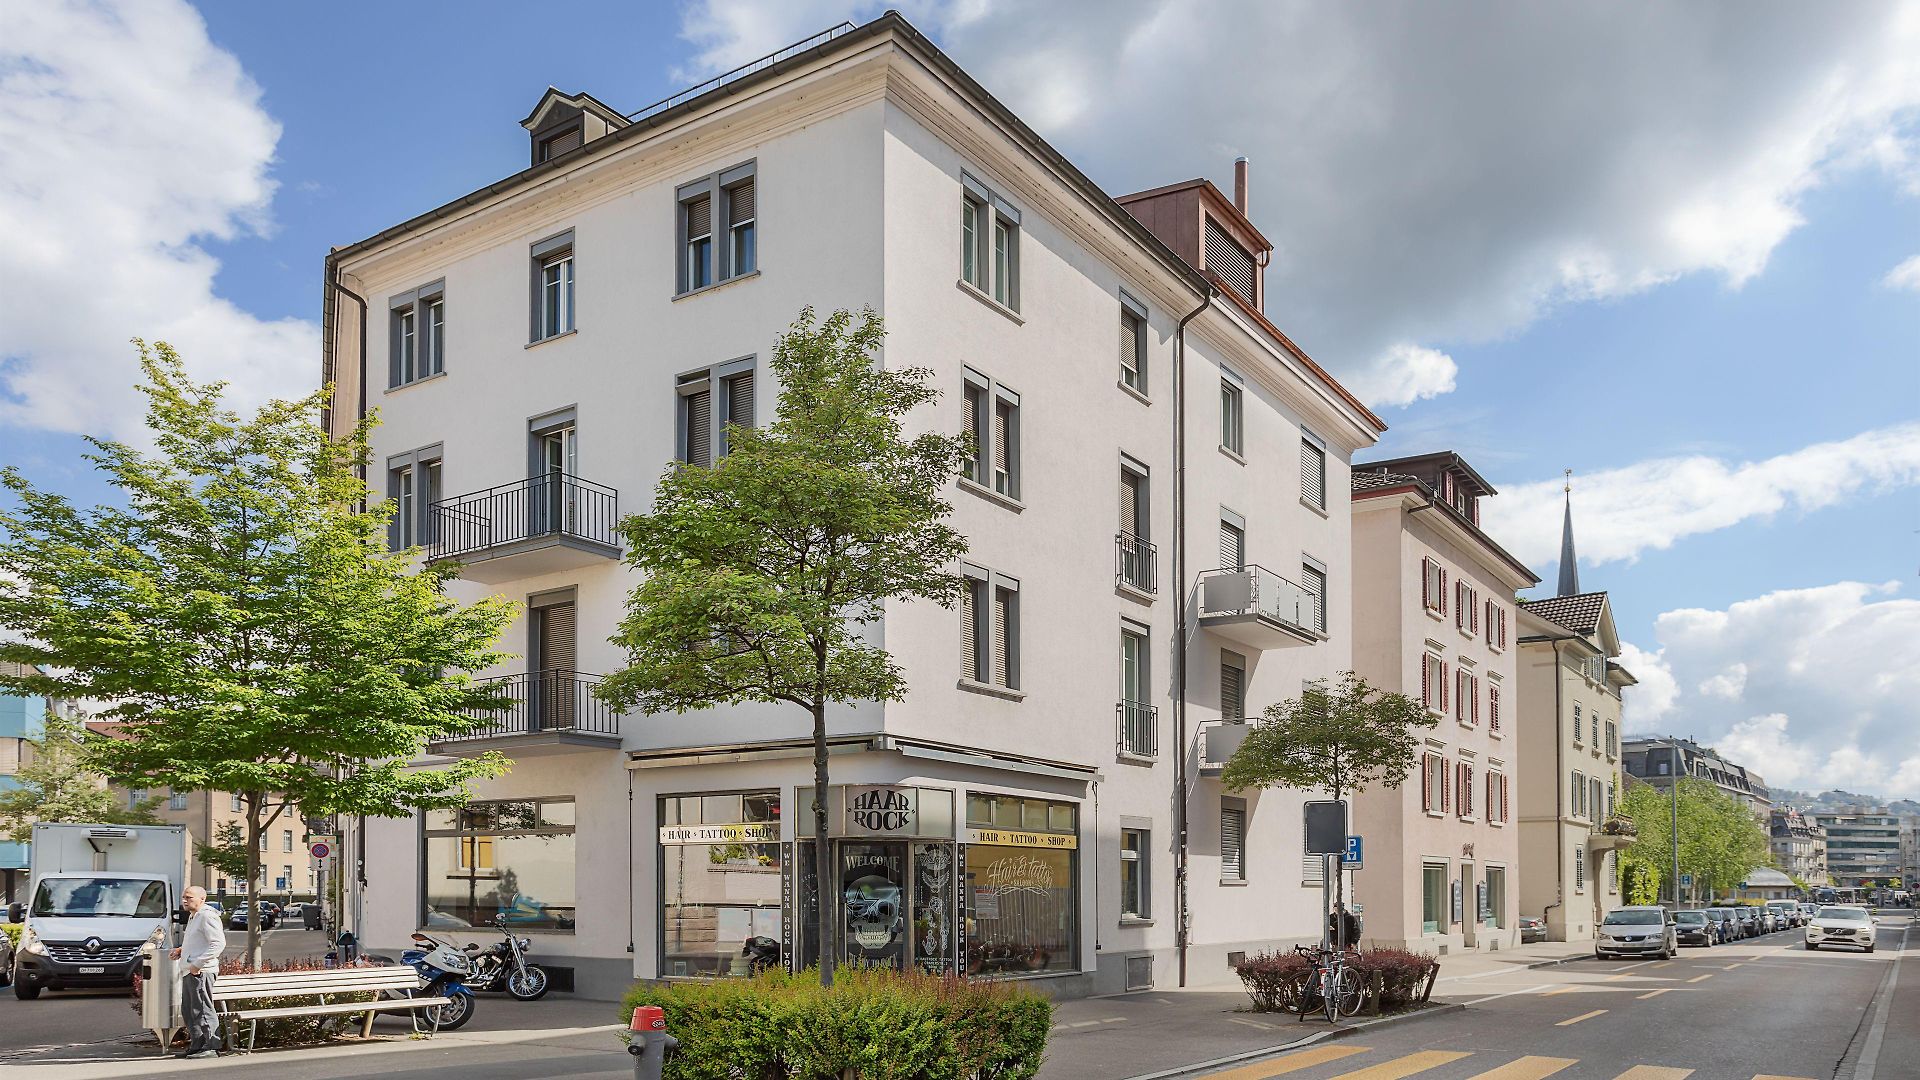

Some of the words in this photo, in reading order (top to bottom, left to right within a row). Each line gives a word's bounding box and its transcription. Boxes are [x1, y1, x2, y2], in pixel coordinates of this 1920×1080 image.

[854, 789, 910, 811] HAAR
[853, 810, 910, 831] ROCK
[668, 829, 691, 840] HAIR
[699, 828, 737, 839] TATTOO
[744, 827, 772, 838] SHOP
[979, 831, 999, 842] HAIR
[1009, 833, 1038, 845] TATTOO
[1047, 836, 1066, 846] SHOP
[1347, 838, 1357, 851] P
[784, 852, 791, 866] WE
[845, 855, 900, 873] WELCOME
[958, 853, 965, 867] WE
[783, 874, 791, 909] WANNA
[783, 916, 791, 945] ROCK
[783, 952, 791, 973] YOU
